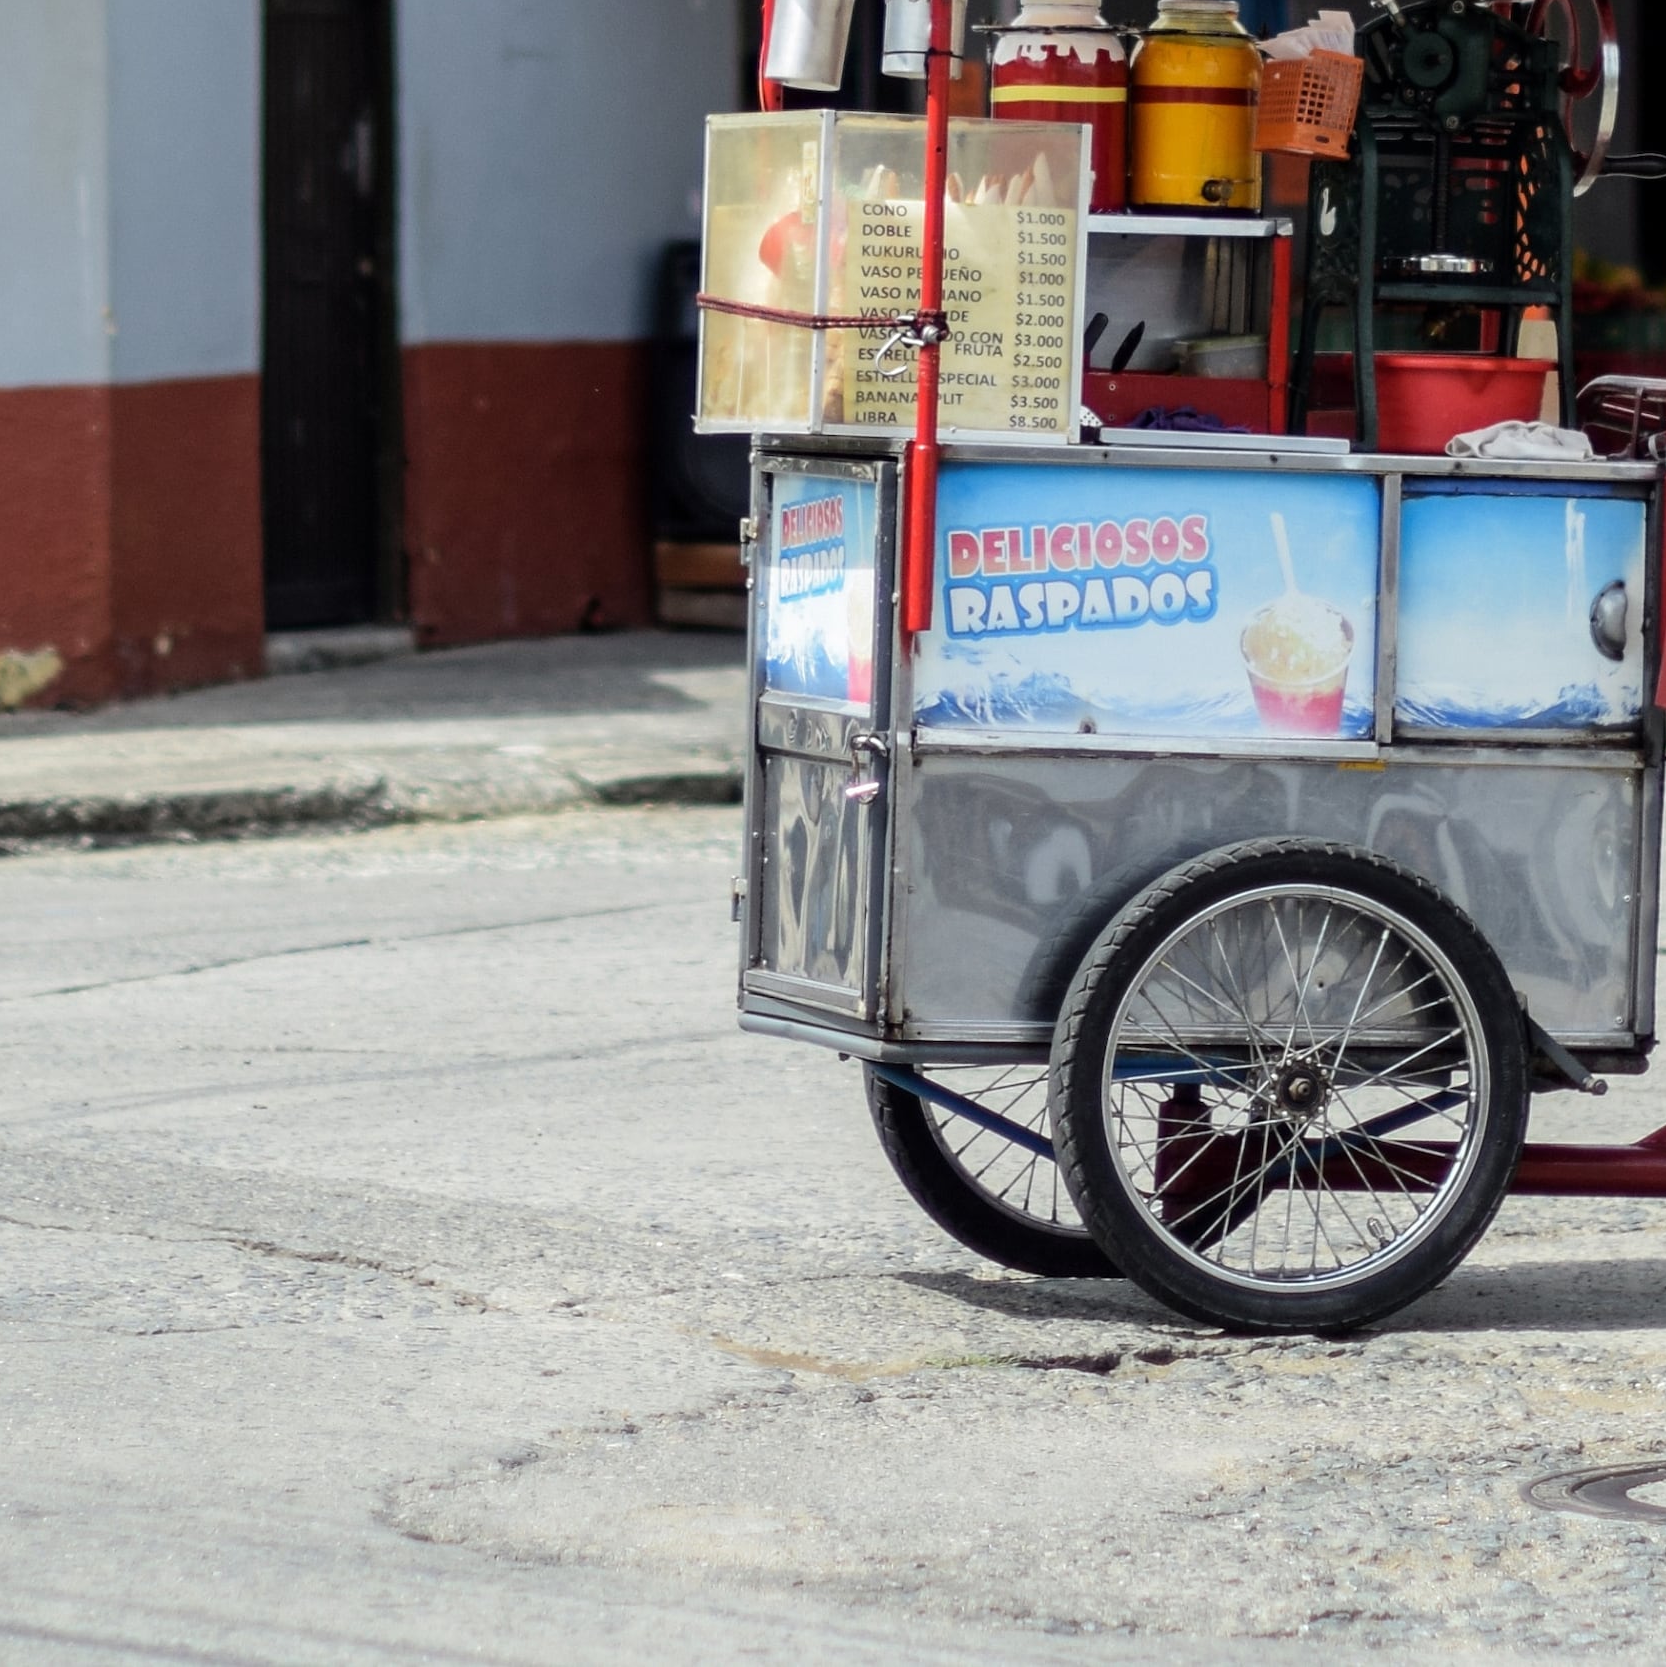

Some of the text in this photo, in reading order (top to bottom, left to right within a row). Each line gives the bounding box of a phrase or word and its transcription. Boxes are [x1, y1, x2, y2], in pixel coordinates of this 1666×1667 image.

[863, 204, 1065, 226] CONO $1.000
[862, 224, 1066, 246] DOBLE $1.500
[862, 245, 1066, 266] KUKURUO $1.500
[861, 265, 1065, 286] VASO PEUEÑO $1.000
[861, 286, 1065, 307] VASO MIANO $1.500
[860, 307, 900, 319] VASO
[1016, 312, 1064, 327] $2.000
[955, 343, 1003, 357] FRUTA
[970, 332, 1003, 345] CON
[1015, 333, 1063, 348] $3.000
[858, 348, 1062, 368] ESRELL $2.500
[856, 370, 1060, 389] ESTRELL SPECIAL $3.000
[856, 391, 1058, 409] BANANA LIT $3.500
[855, 412, 1057, 429] LIBRA $8.500
[781, 495, 843, 549] DELICIOSOS
[948, 514, 1209, 579] DELICIOSOS
[780, 545, 845, 597] RASPADOS
[949, 570, 1213, 634] RASPADOS
